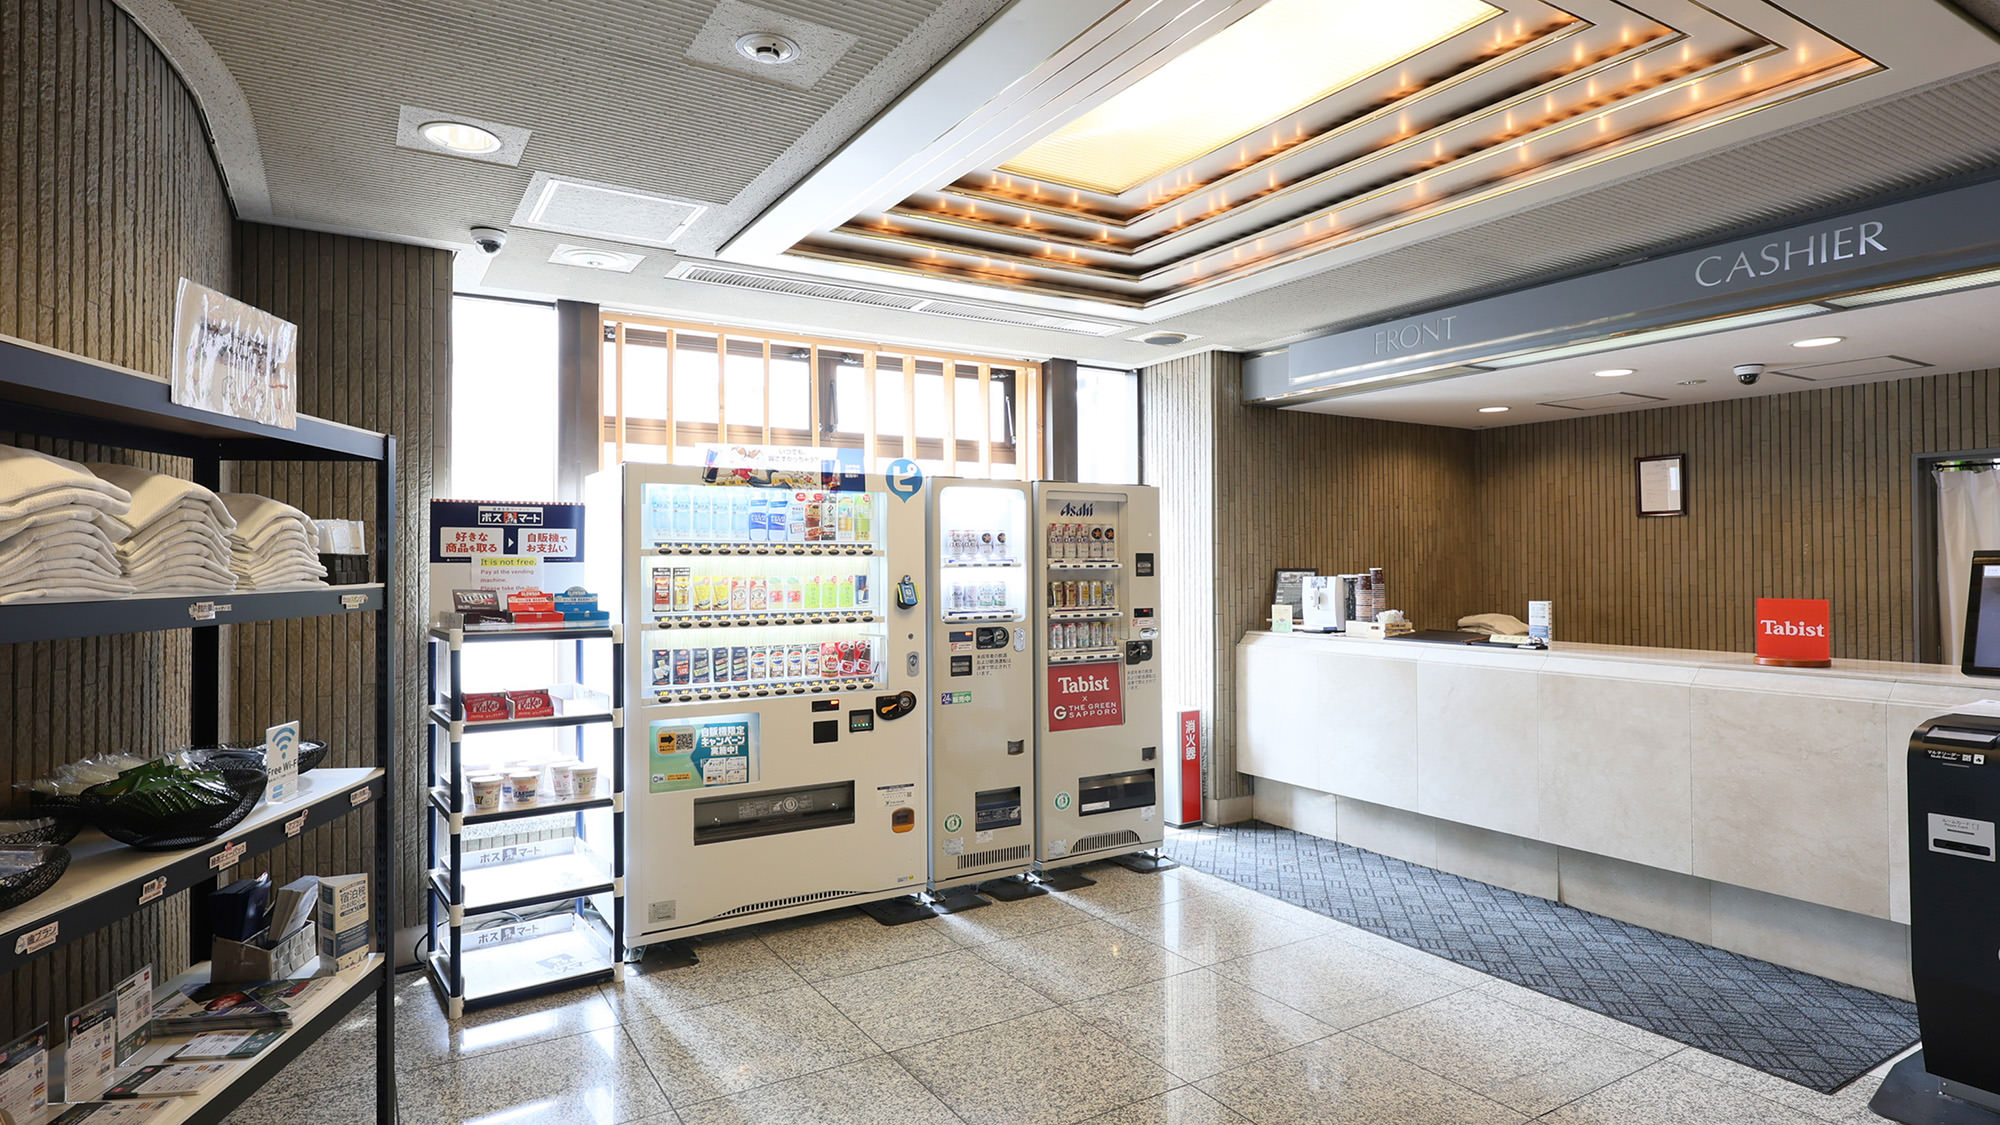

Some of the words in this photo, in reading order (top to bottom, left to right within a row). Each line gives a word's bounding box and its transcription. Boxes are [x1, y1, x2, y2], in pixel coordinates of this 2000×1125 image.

[1694, 221, 1889, 288] CASHIER
[1372, 314, 1458, 355] FRONT
[1060, 502, 1094, 517] Asahi
[481, 512, 502, 523] ボス
[518, 512, 540, 524] マート
[455, 531, 489, 542] 好きな
[527, 532, 568, 543] 自販機で
[445, 542, 498, 553] 商品を取る
[526, 543, 568, 553] お支払い
[481, 558, 488, 566] It
[490, 558, 498, 566] is
[499, 558, 514, 566] not
[517, 558, 537, 566] free.
[1760, 619, 1825, 637] Tabist
[1058, 675, 1110, 694] Tabist
[1088, 702, 1117, 710] GREEN
[1069, 708, 1118, 719] SAPPORO
[701, 725, 745, 737] 自販機限定
[701, 736, 745, 747] キャンペーン
[1185, 719, 1196, 760] 消火器
[268, 766, 282, 776] Free
[480, 852, 500, 864] ボス
[517, 847, 540, 857] マート
[478, 931, 499, 944] ボス
[516, 925, 540, 935] マート
